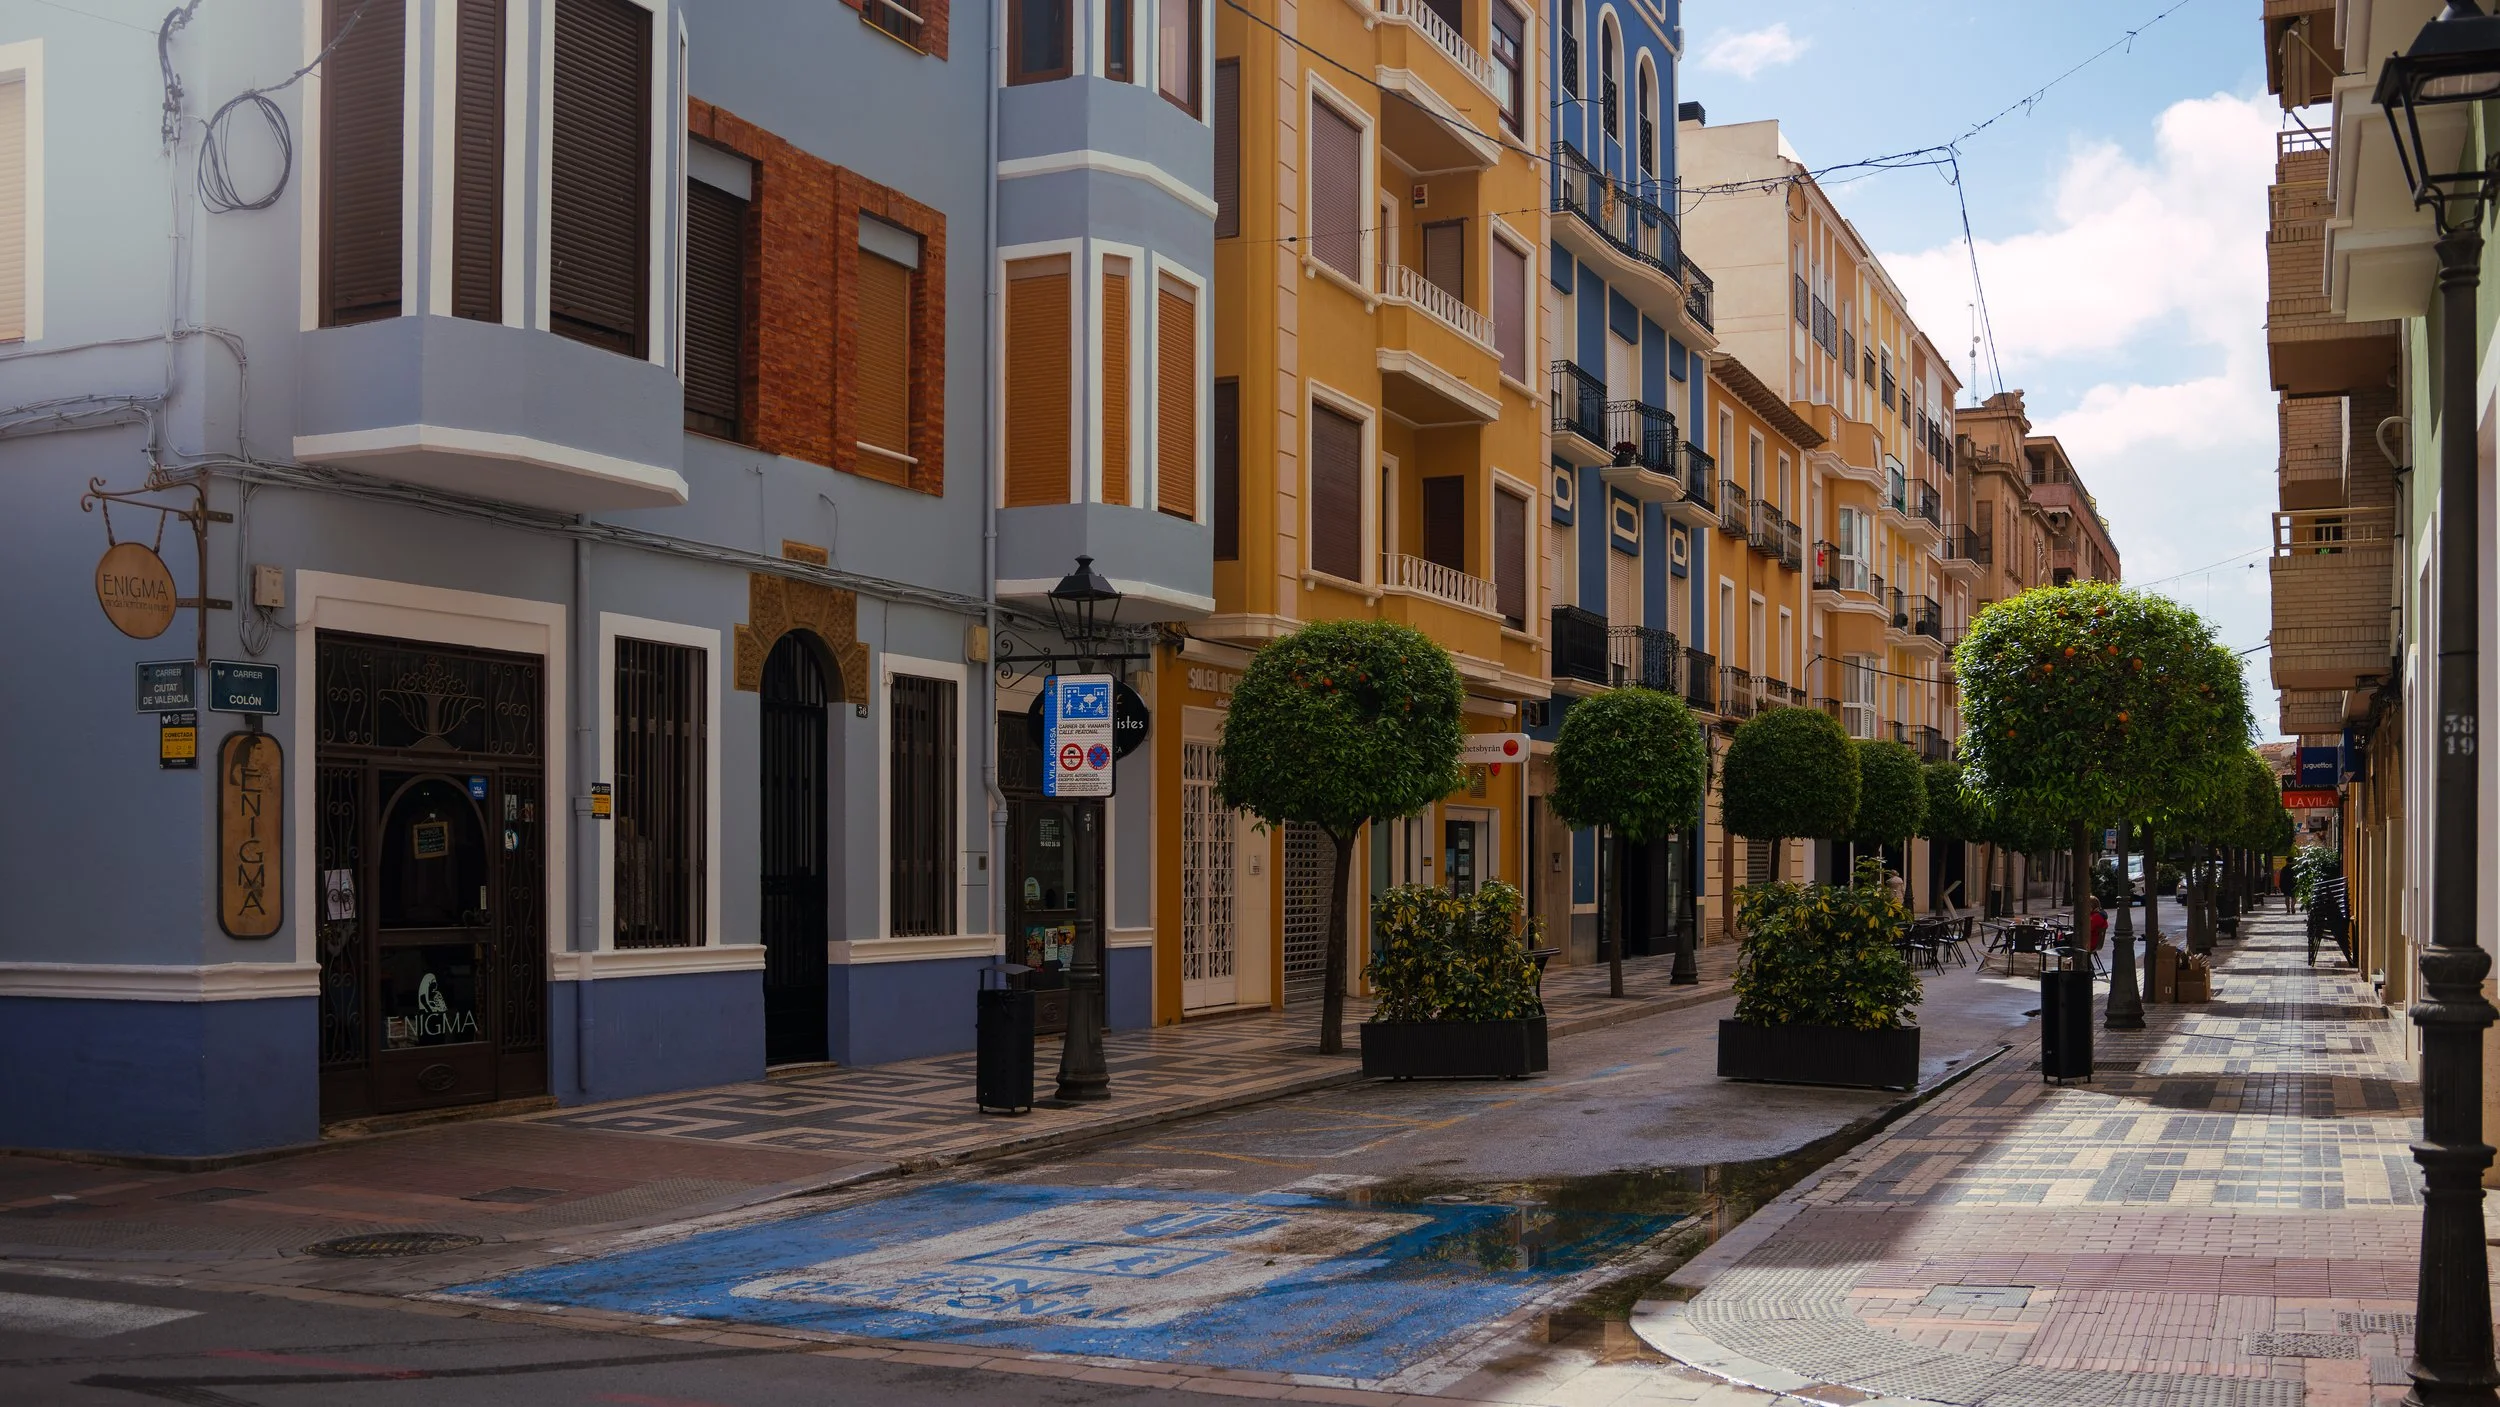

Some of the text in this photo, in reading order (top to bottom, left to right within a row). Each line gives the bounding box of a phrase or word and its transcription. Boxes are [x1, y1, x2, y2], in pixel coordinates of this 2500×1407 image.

[103, 573, 168, 600] ENIGMA
[155, 668, 181, 677] CARRER
[233, 670, 262, 679] CARRER
[1189, 667, 1218, 693] SOLER
[154, 683, 177, 692] CIUTAT
[143, 697, 153, 705] DE
[229, 694, 261, 706] COLÓN
[1116, 715, 1144, 729] istes
[2444, 714, 2475, 734] 38
[1049, 727, 1057, 758] JOIOSA
[1464, 744, 1501, 754] hetsbyrån
[1049, 781, 1056, 793] LA
[2289, 797, 2335, 807] LA VILA
[238, 767, 266, 916] ENIGMA
[387, 1009, 479, 1039] ENIGMA
[767, 1280, 1131, 1322] PEATONAL
